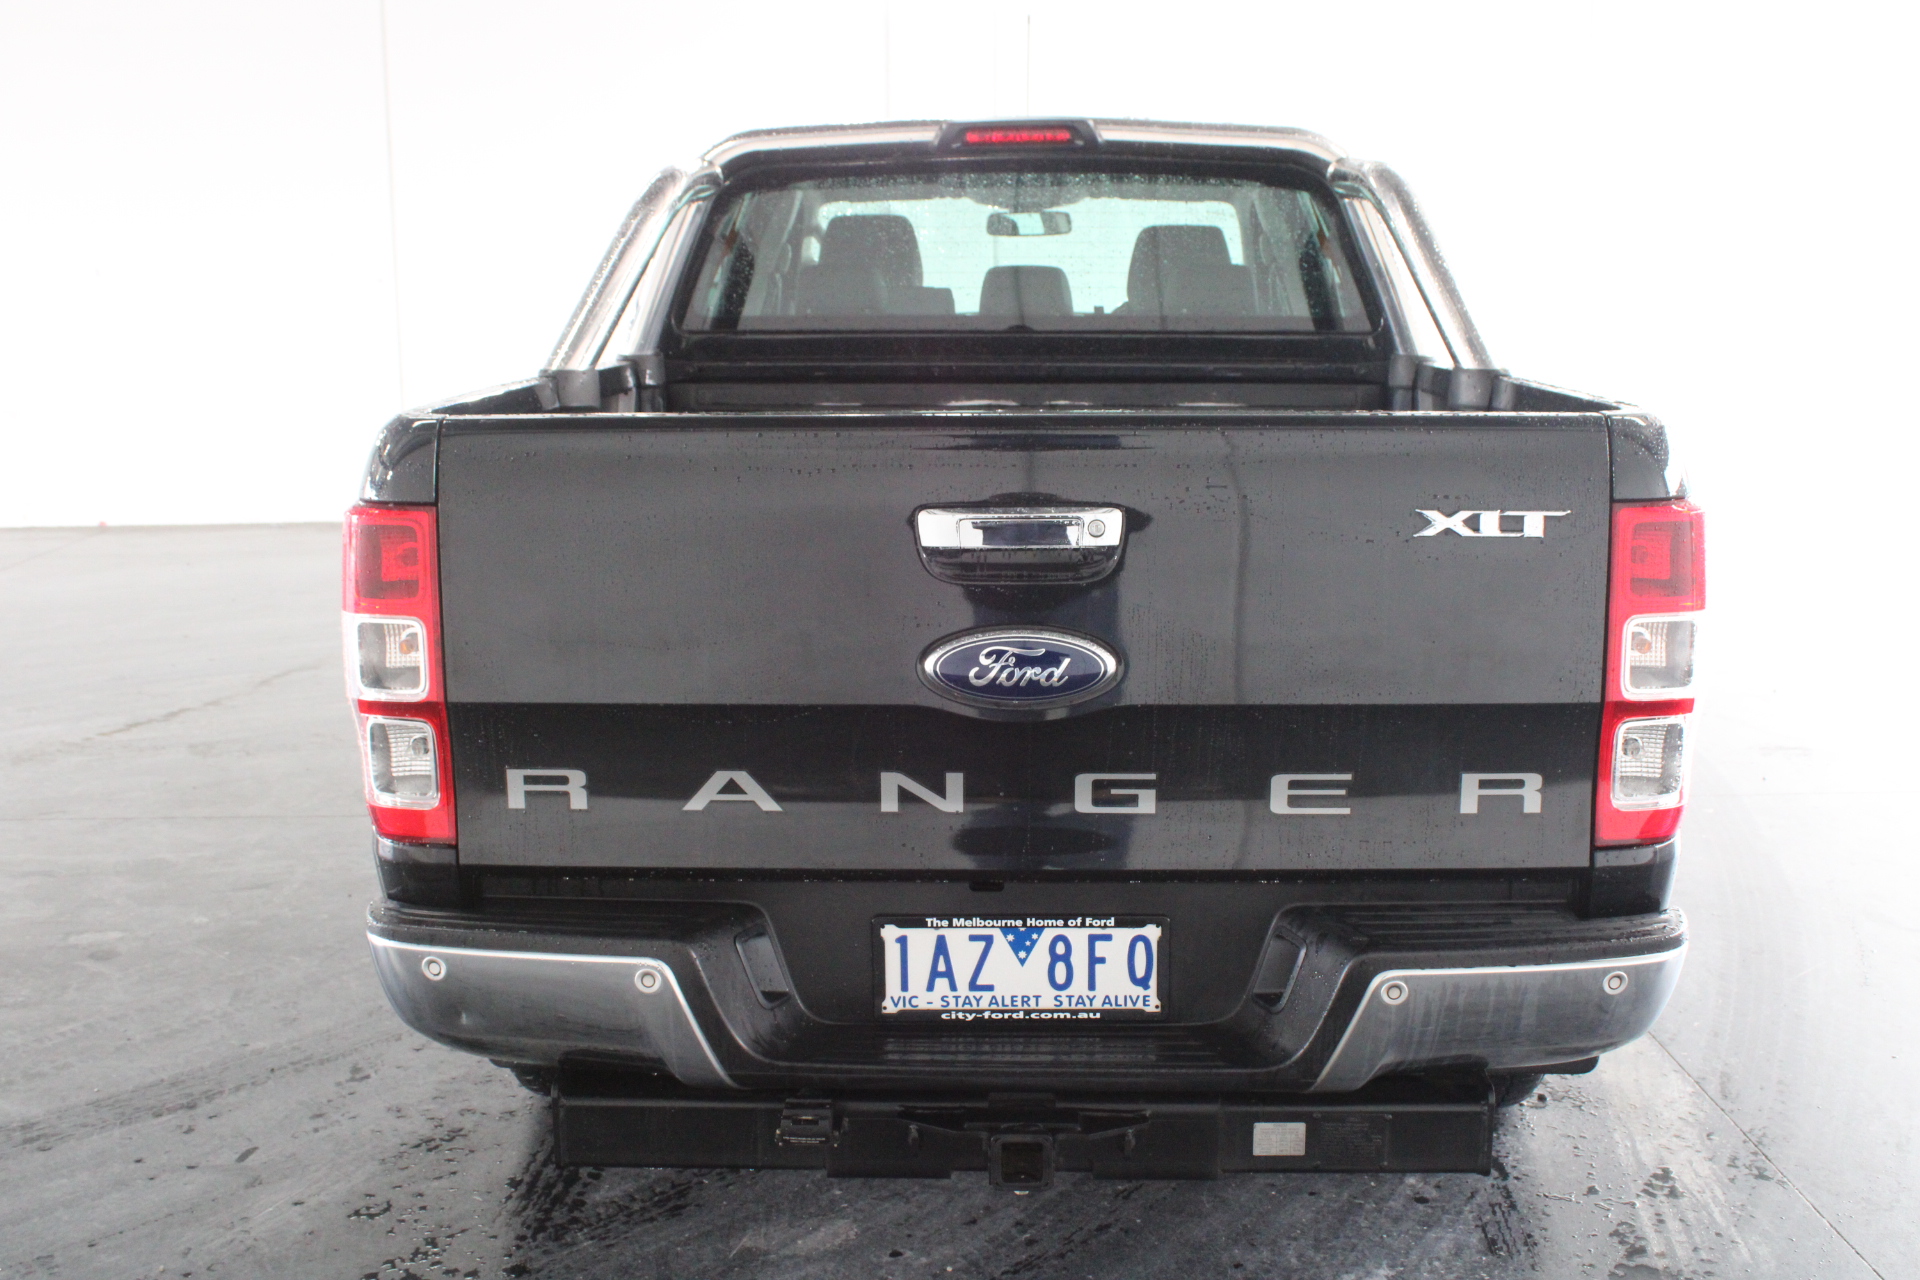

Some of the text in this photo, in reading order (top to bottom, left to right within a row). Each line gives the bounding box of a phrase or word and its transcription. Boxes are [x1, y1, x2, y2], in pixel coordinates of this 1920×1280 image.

[1413, 509, 1571, 538] XLT
[968, 646, 1071, 687] Ford
[506, 768, 1542, 814] RANGER
[925, 917, 1115, 927] The Melbourne Home of Ford
[890, 995, 919, 1008] VIC
[940, 995, 983, 1008] STAY
[988, 995, 1042, 1008] ALERT
[1053, 995, 1096, 1008] STAY
[1101, 995, 1151, 1008] ALIVE
[940, 1010, 1101, 1021] city-ford.com.au
